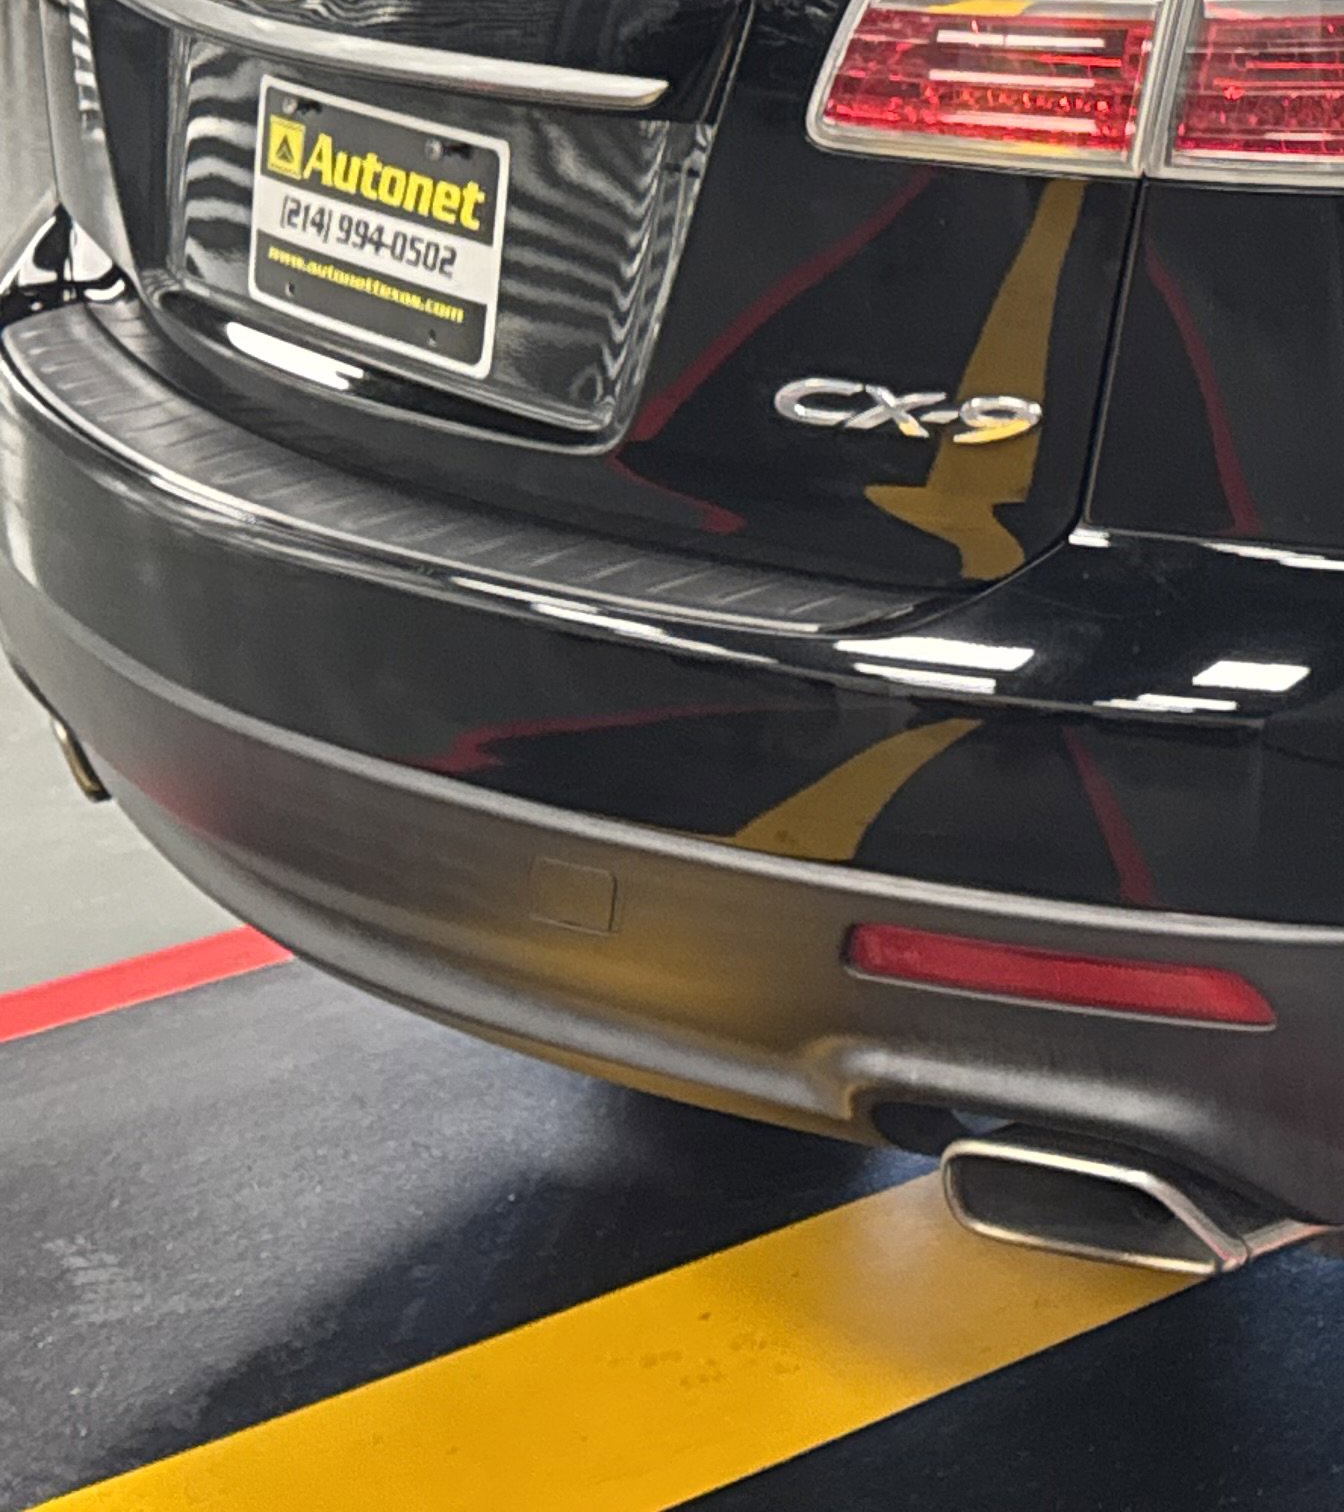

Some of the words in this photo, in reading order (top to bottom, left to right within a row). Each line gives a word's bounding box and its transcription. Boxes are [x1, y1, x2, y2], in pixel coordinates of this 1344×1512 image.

[303, 133, 485, 231] Autonet
[280, 194, 333, 244] (214)
[335, 213, 457, 278] 994-0502
[774, 377, 1042, 444] CX-9
